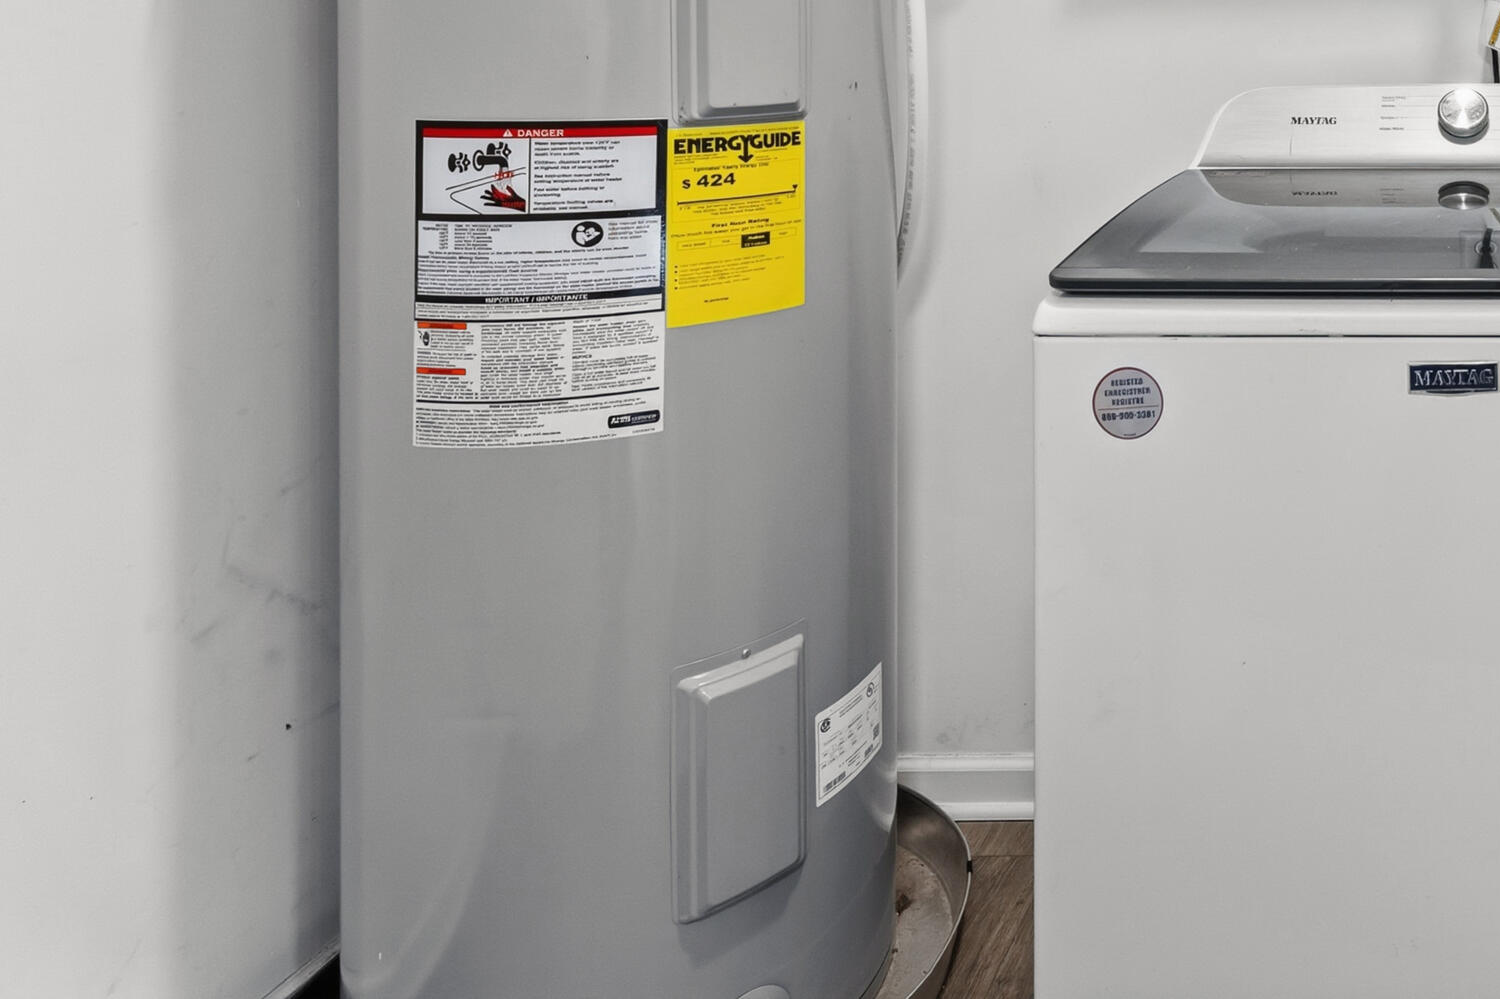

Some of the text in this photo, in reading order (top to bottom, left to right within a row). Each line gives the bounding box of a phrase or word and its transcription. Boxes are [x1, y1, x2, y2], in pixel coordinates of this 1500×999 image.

[1290, 116, 1337, 125] MAYTAG
[517, 129, 564, 137] DANGER
[696, 172, 736, 187] 424
[1413, 368, 1494, 386] MAYTAG
